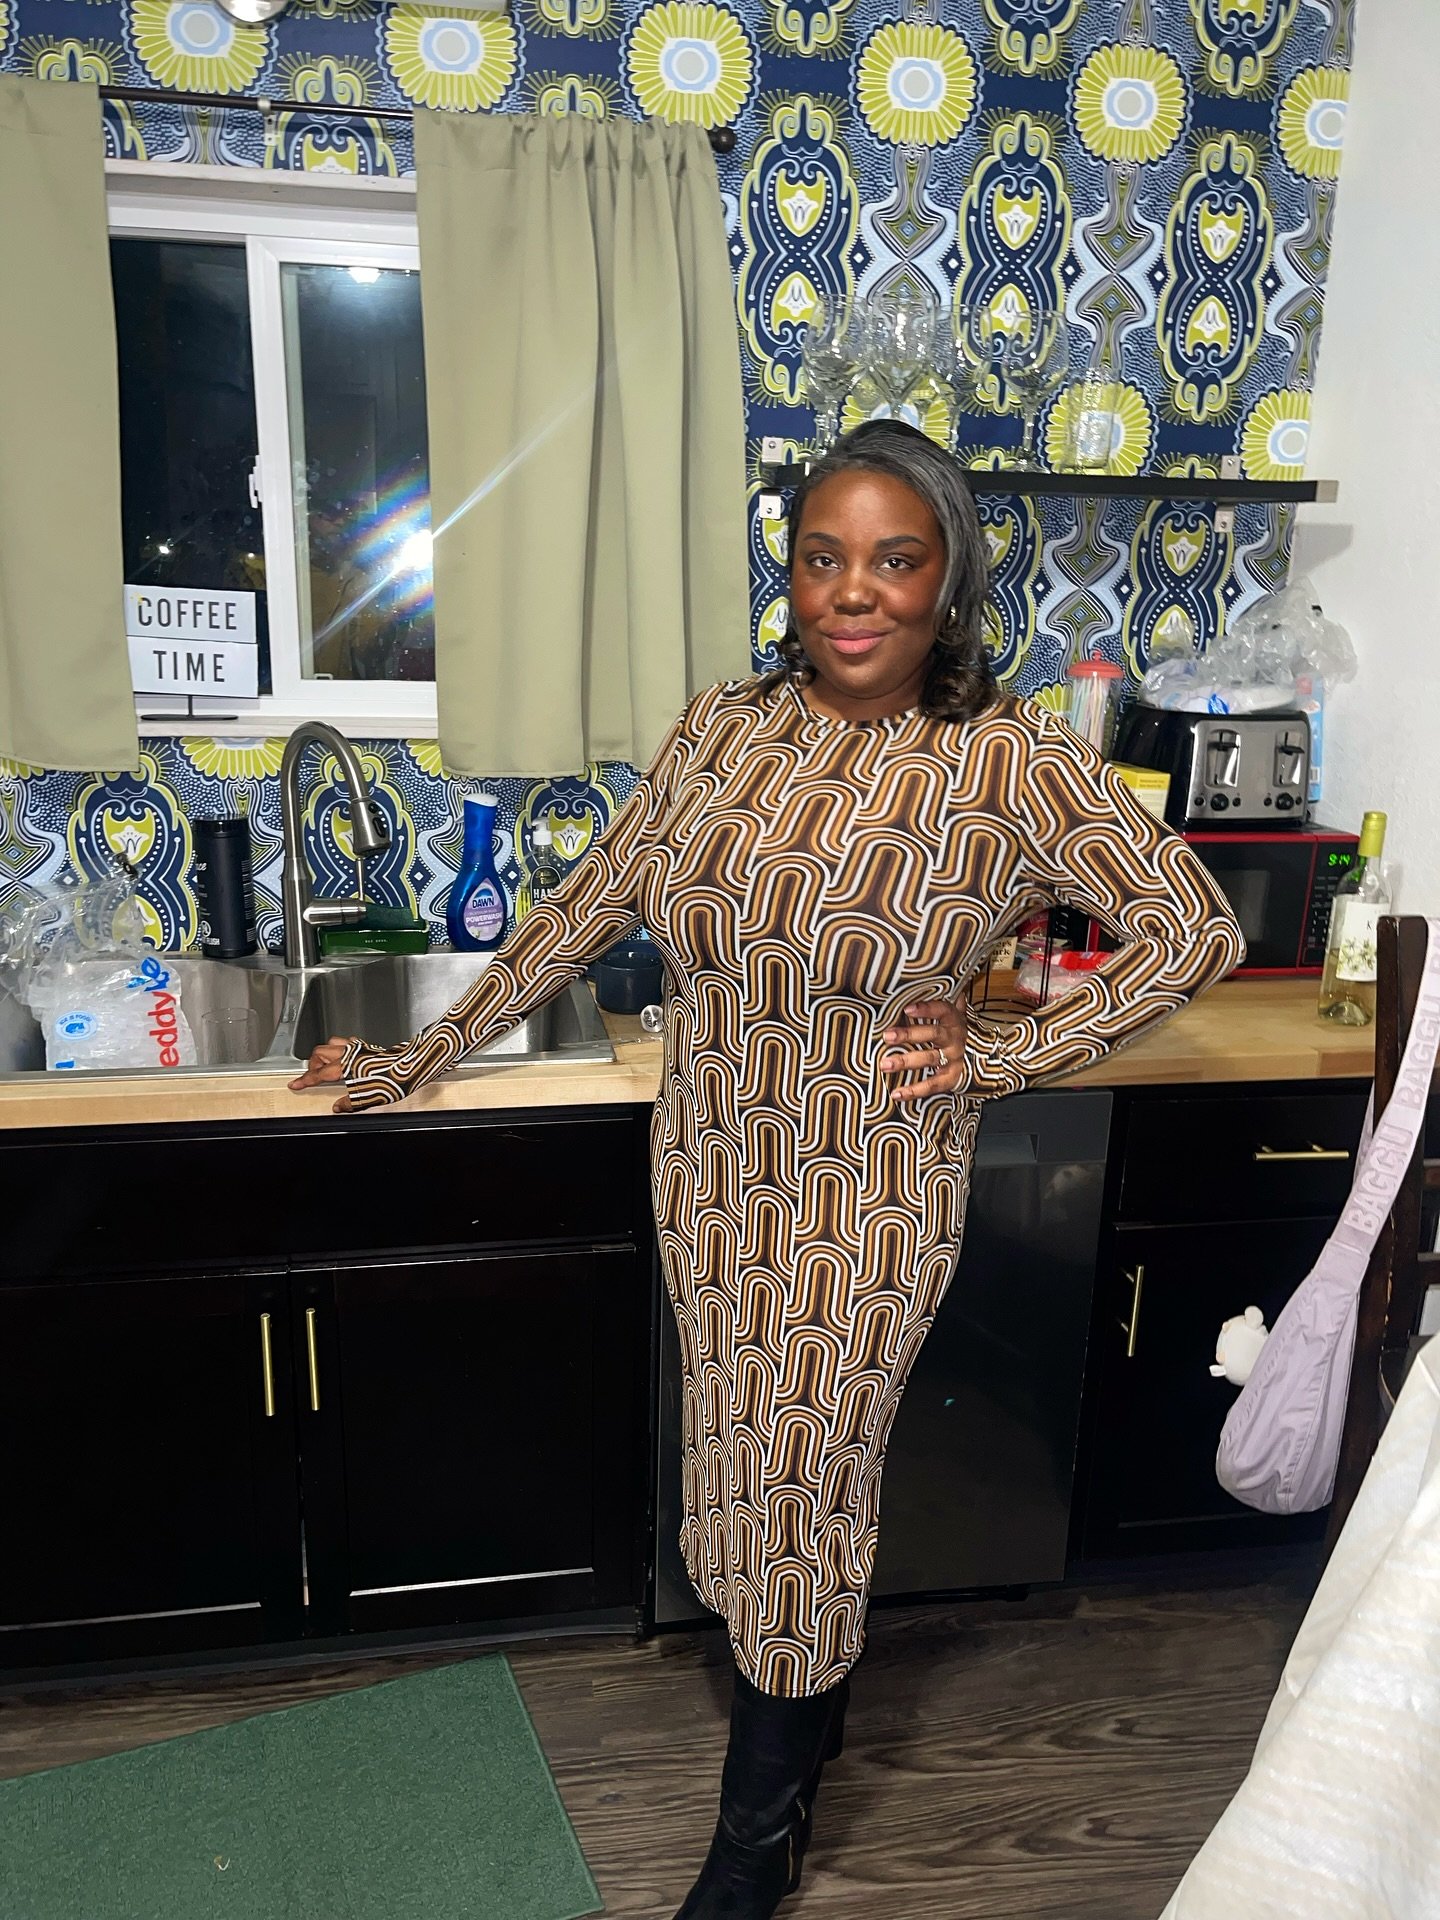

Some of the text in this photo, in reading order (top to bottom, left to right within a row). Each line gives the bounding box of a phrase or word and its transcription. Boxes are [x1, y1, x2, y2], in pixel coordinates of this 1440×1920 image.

[138, 597, 237, 630] COFFEE
[153, 650, 225, 682] TIME
[472, 897, 495, 909] DAWN
[533, 888, 554, 899] HAN
[147, 991, 180, 1067] eddy
[1344, 1122, 1413, 1236] BAGGU
